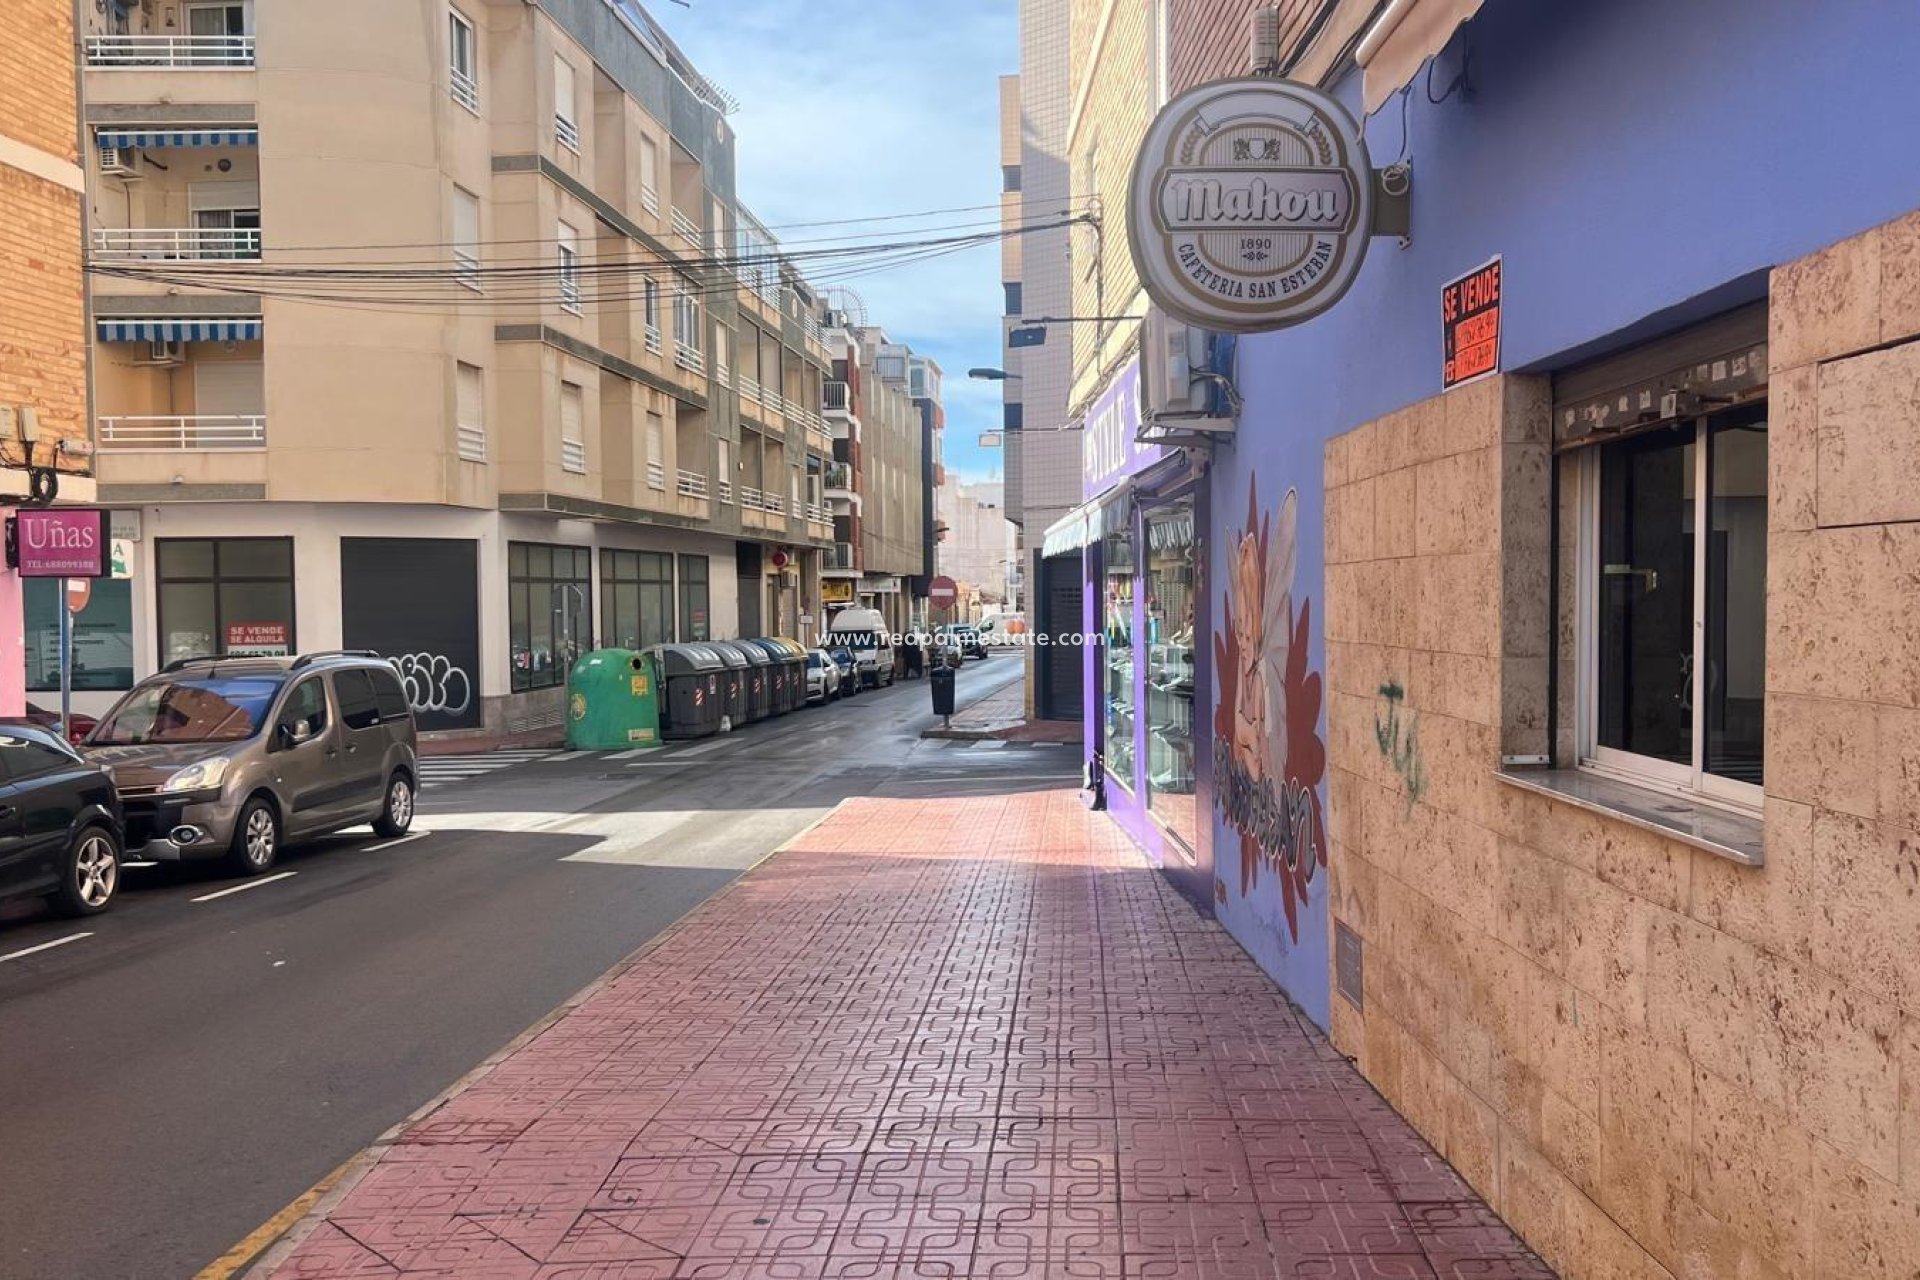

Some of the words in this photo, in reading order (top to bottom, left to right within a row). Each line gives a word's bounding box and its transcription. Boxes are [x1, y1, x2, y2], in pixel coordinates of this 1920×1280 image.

[1172, 177, 1338, 221] Mahou
[1241, 239, 1271, 250] 1890
[1178, 243, 1243, 298] CAFETERIA
[1249, 281, 1276, 298] SAN
[1279, 241, 1332, 294] ESTEBAN
[1444, 287, 1457, 323] SE
[1460, 265, 1499, 314] VENDE
[25, 519, 94, 549] Uñas
